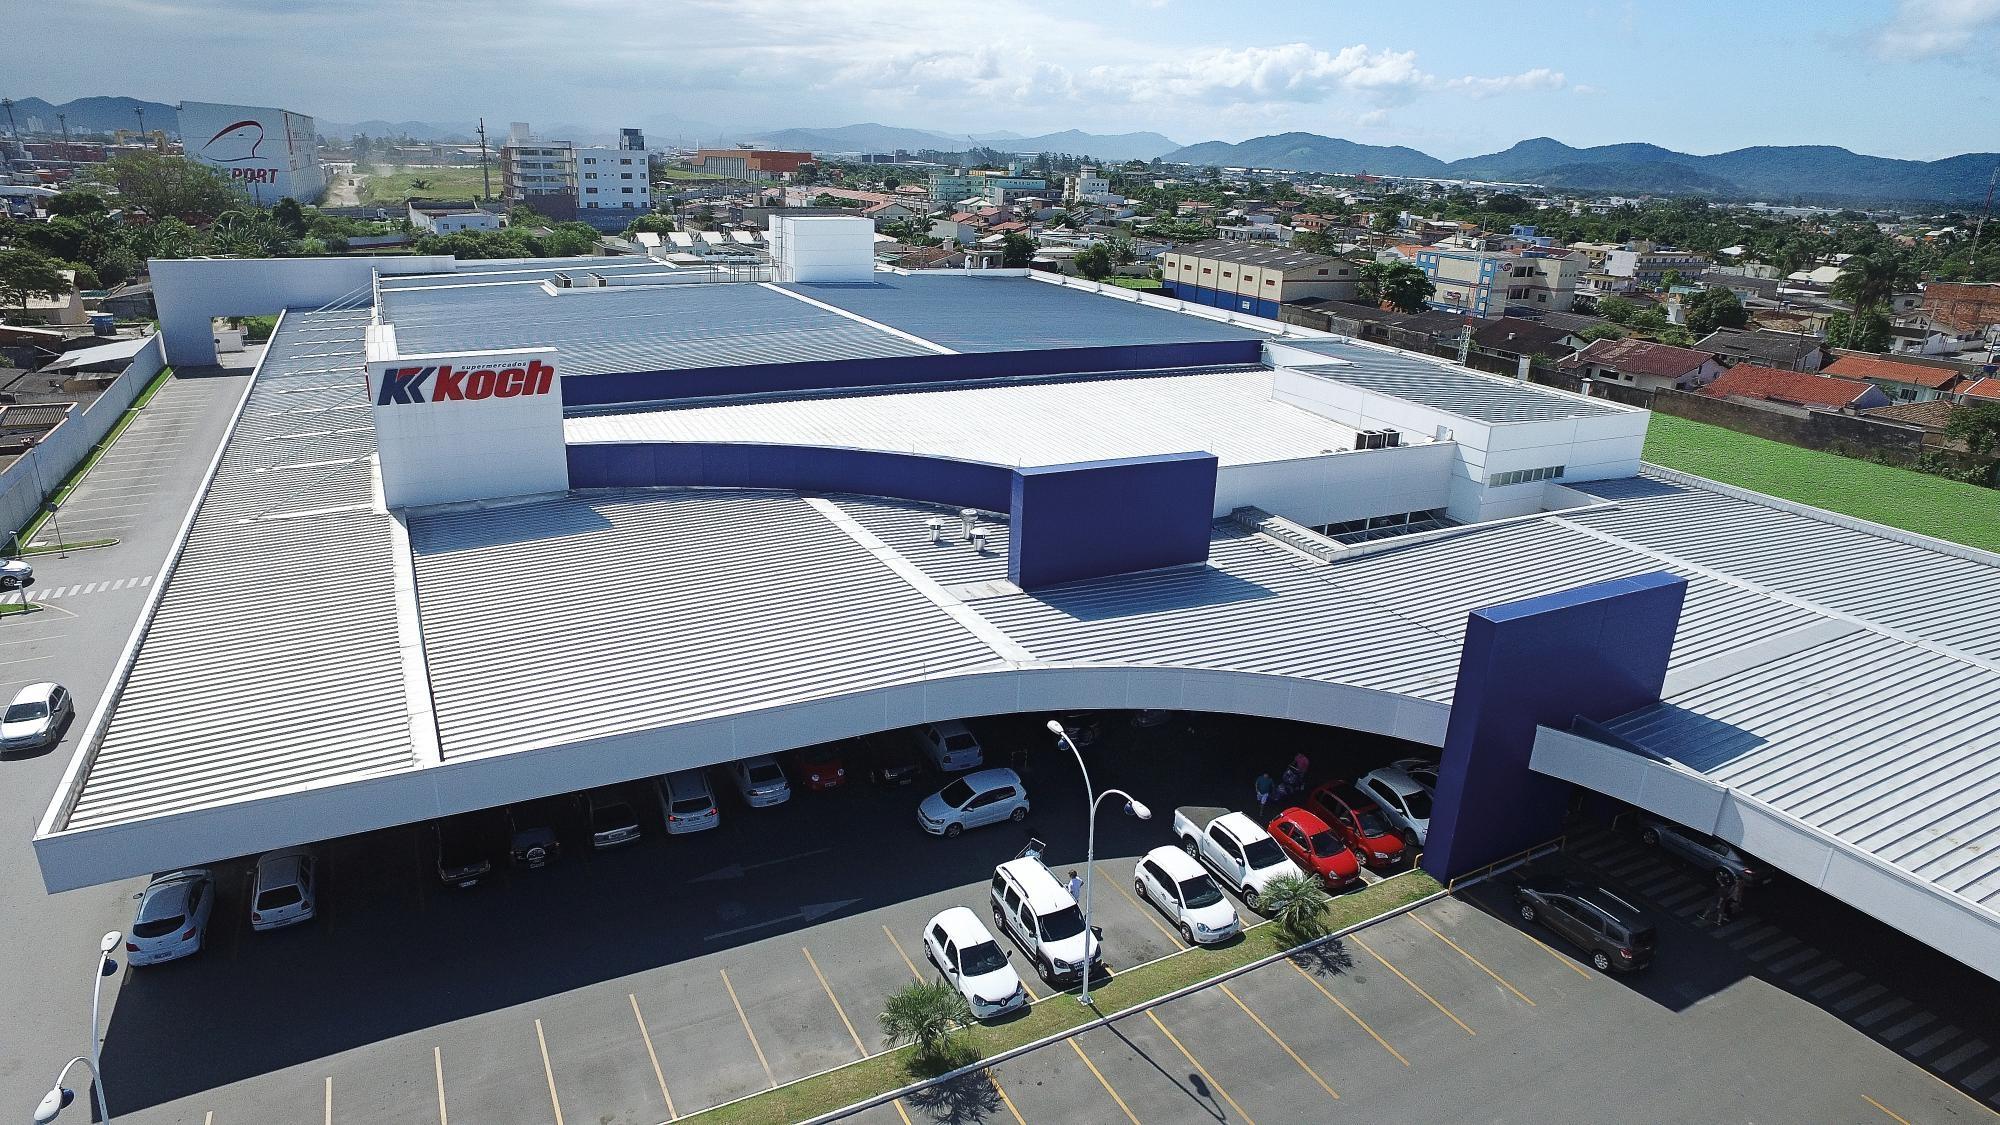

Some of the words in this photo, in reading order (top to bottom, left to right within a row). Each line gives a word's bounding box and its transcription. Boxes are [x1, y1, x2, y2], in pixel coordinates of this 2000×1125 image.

[226, 168, 278, 183] PORT
[461, 361, 526, 370] supermercados
[432, 359, 554, 402] koch
